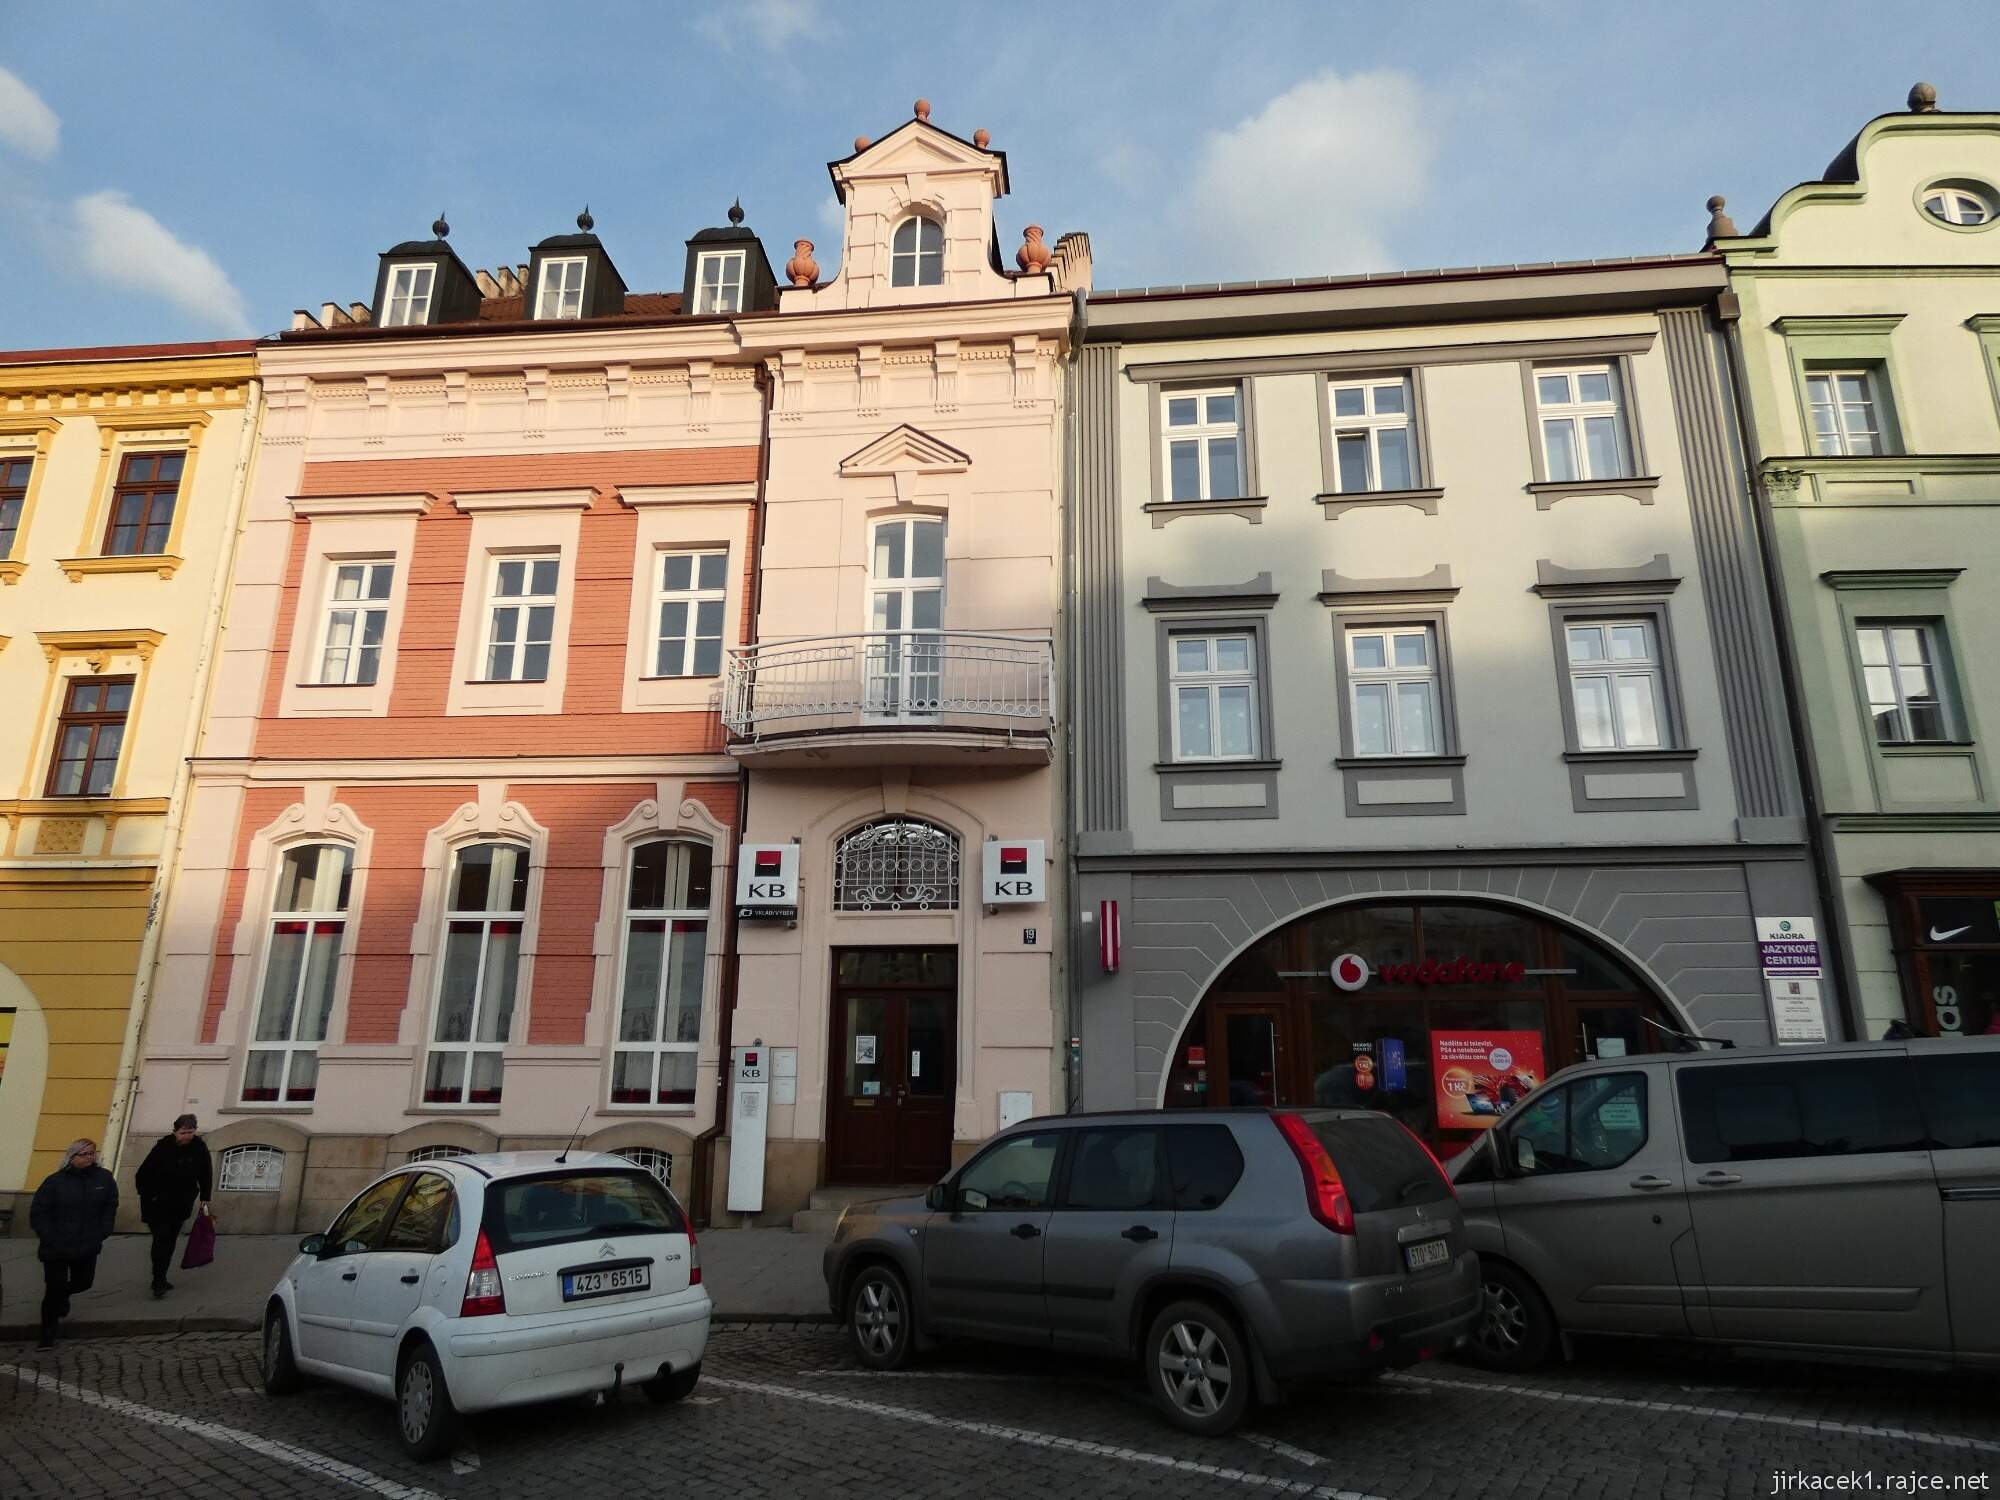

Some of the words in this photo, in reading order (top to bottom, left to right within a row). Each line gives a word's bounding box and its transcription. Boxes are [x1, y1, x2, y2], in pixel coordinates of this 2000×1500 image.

[748, 882, 786, 898] KB
[994, 881, 1033, 896] KB
[1025, 929, 1035, 940] 19
[1762, 942, 1816, 954] JAZYKOVÉ
[1765, 955, 1816, 965] CENTRUM
[1378, 954, 1525, 985] vodafone
[742, 1069, 760, 1078] KB
[576, 1274, 601, 1292] 4Z3
[611, 1269, 643, 1286] 6515
